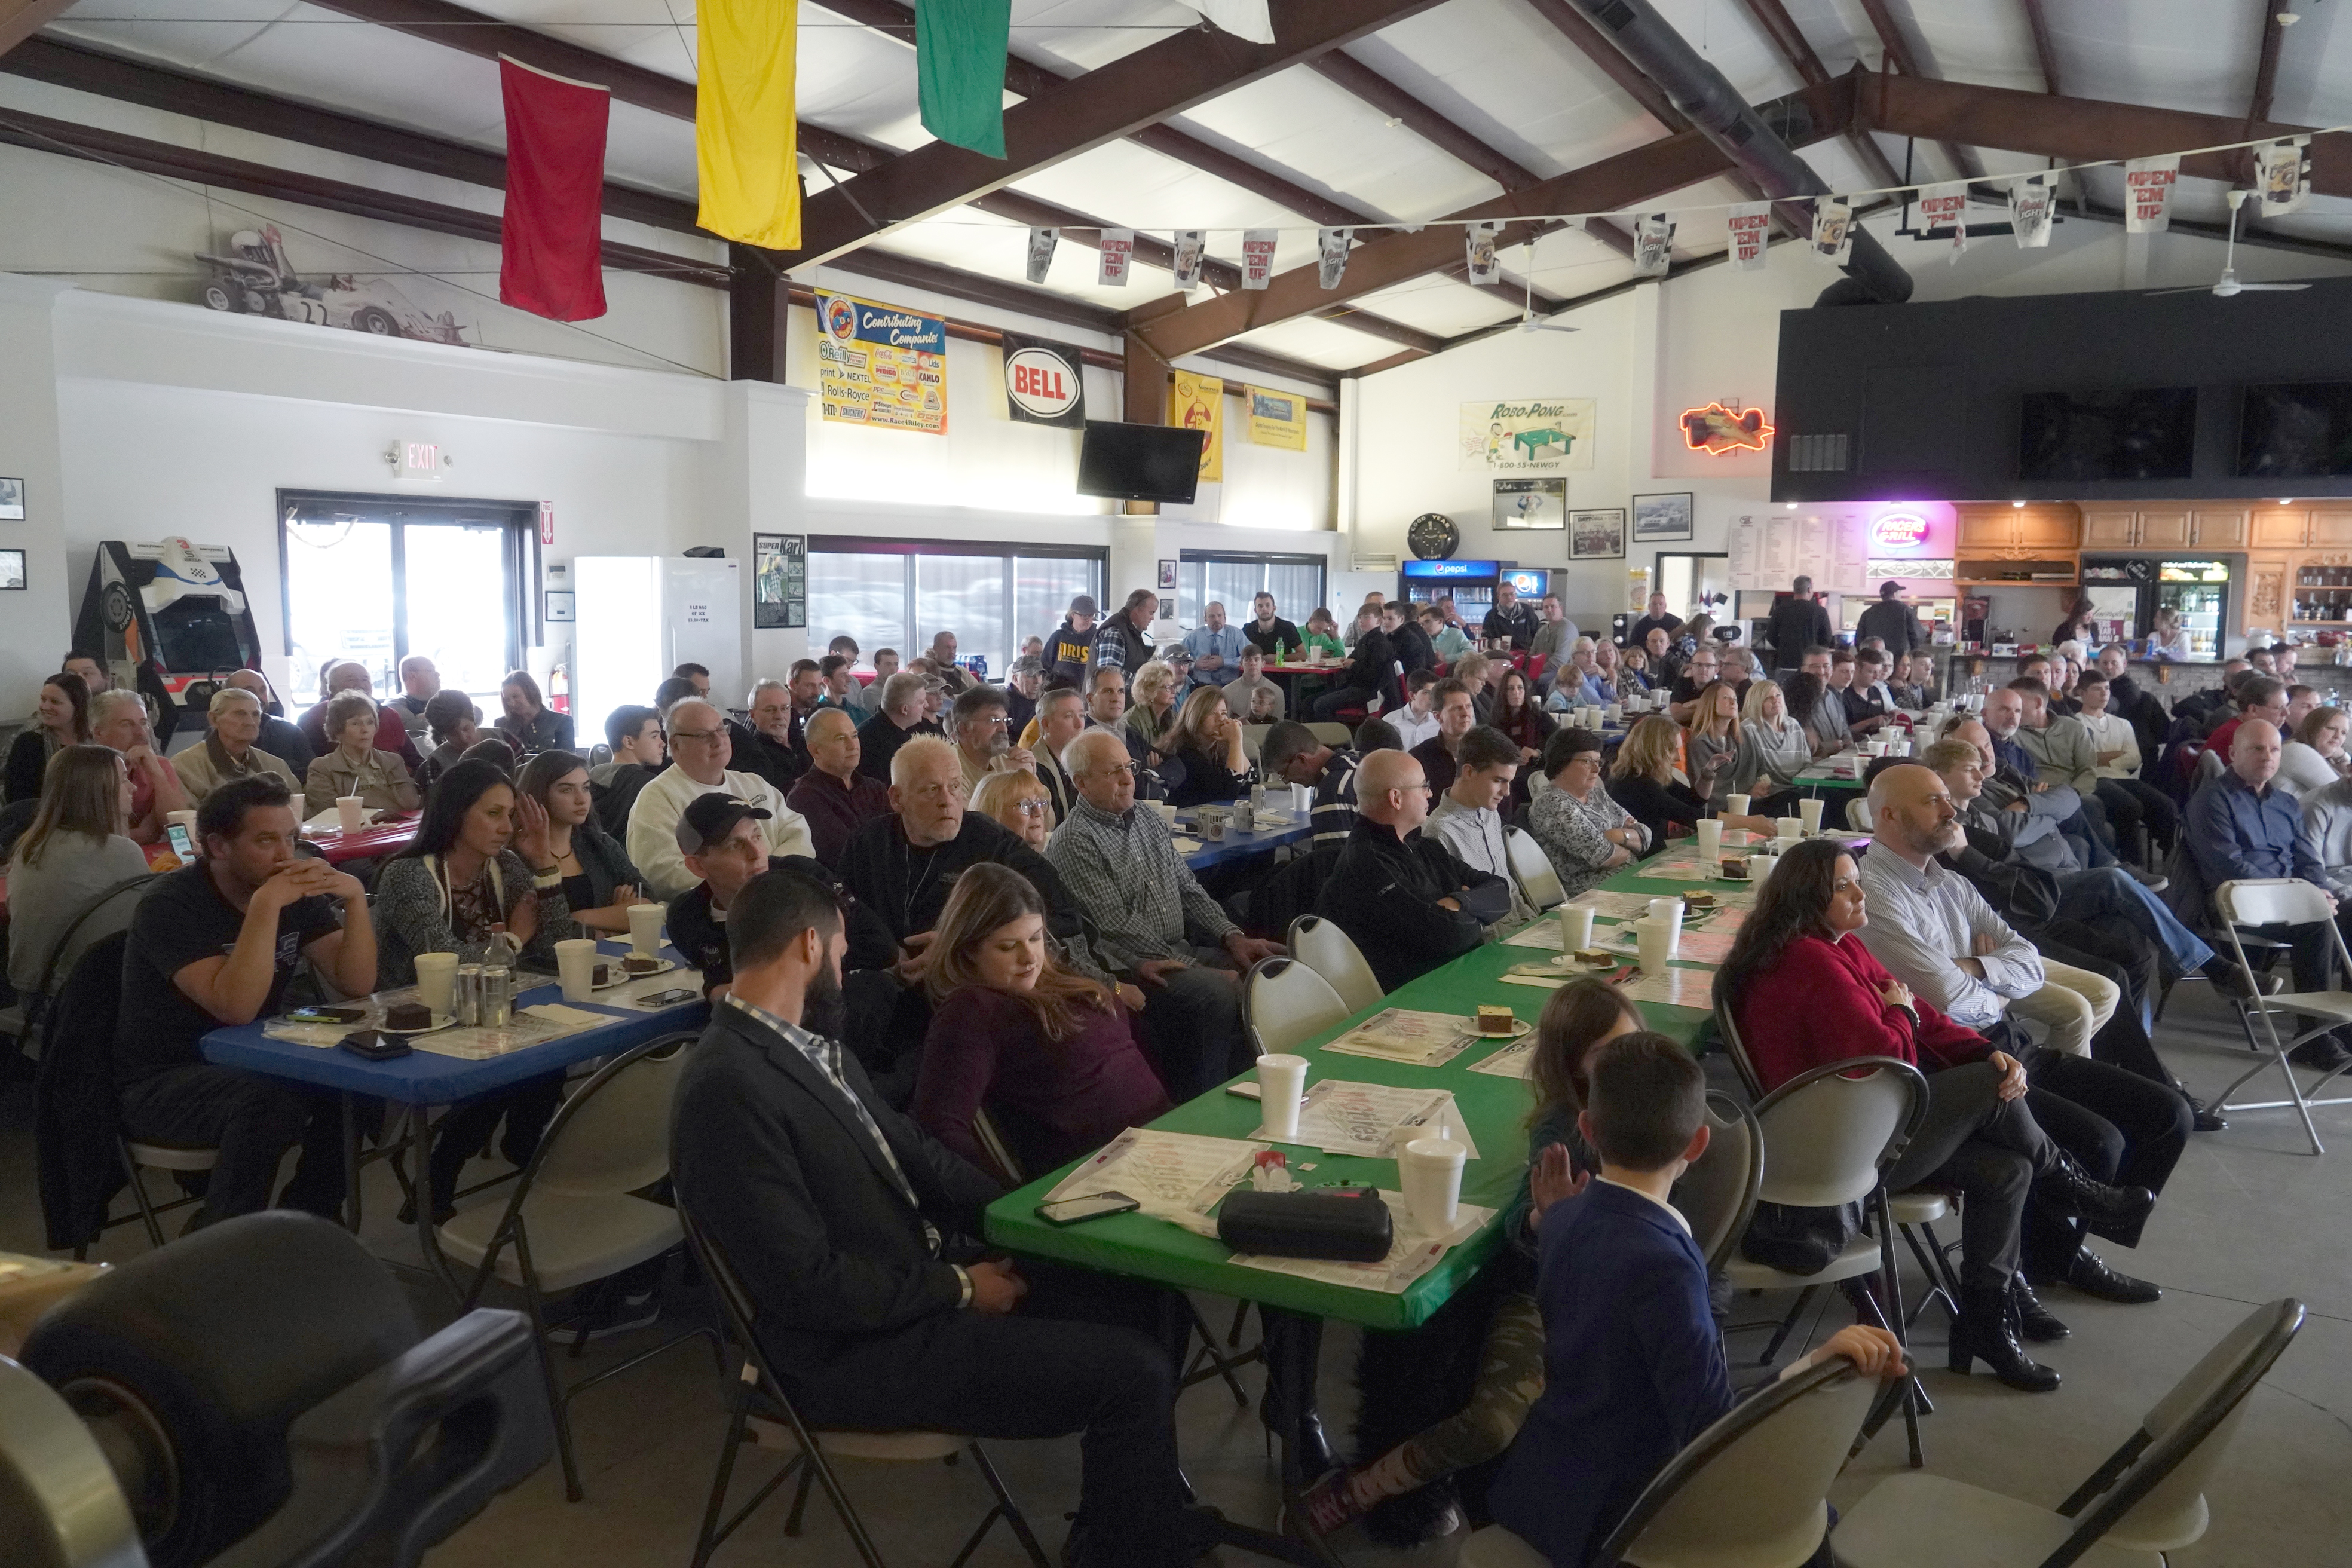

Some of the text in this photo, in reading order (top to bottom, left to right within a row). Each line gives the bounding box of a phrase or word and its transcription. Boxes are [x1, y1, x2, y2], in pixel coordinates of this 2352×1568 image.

[2127, 169, 2177, 186] OPEN
[1921, 195, 1965, 213] OPEN
[2137, 204, 2163, 220] UP
[1728, 214, 1769, 231] OPEN
[1101, 240, 1131, 252] OPEN
[1243, 241, 1276, 253] OPEN
[1738, 246, 1759, 260] UP
[1105, 265, 1122, 277] UP
[1249, 267, 1266, 280] UP
[863, 311, 922, 332] Contributing
[890, 329, 938, 349] Companies
[820, 343, 850, 363] O'Reilly
[929, 359, 939, 368] Lids
[821, 368, 835, 378] print
[847, 372, 871, 383] NEXTEL
[919, 372, 939, 383] KAHLO
[1015, 365, 1066, 400] BELL
[828, 385, 869, 402] Rolls-Royce
[842, 408, 864, 418] SNICKERS
[872, 416, 939, 428] www.Race4Riley.com
[408, 443, 438, 470] EXIT
[1410, 514, 1450, 531] GOOD YEAR
[1882, 520, 1924, 532] RACERS
[1878, 531, 1916, 541] GRILL
[780, 538, 804, 555] Kart
[1445, 565, 1467, 574] pepsi
